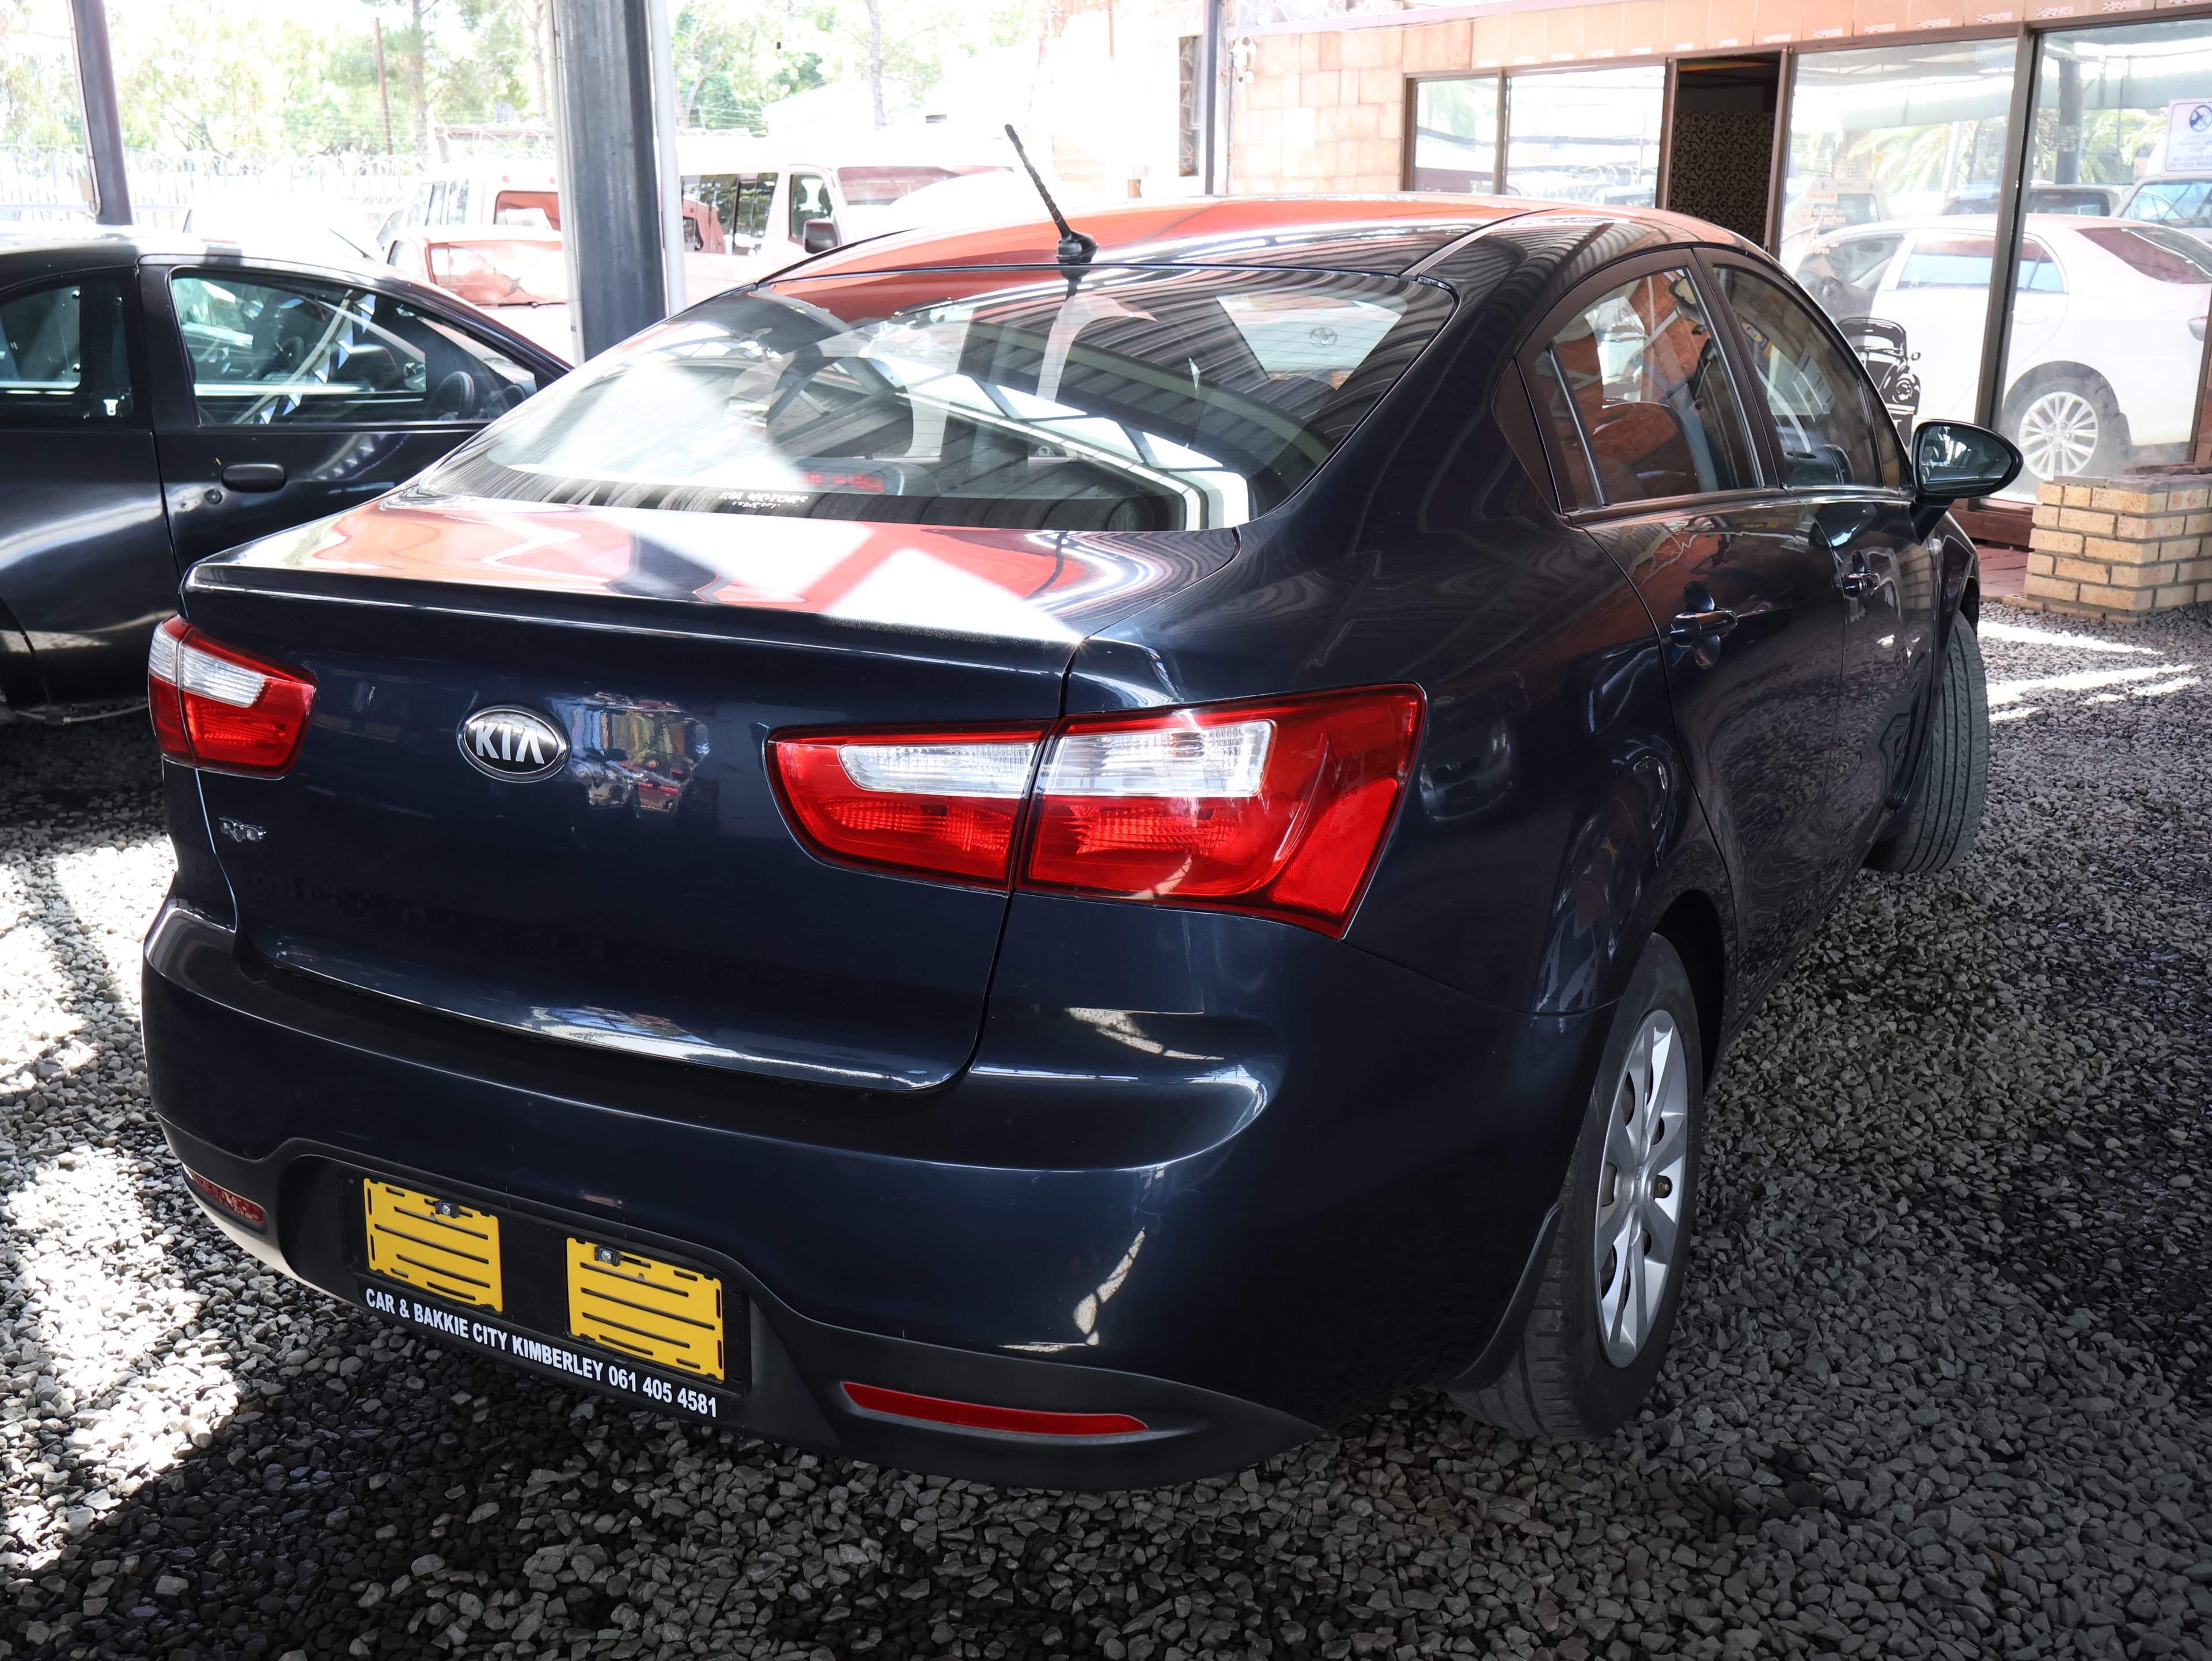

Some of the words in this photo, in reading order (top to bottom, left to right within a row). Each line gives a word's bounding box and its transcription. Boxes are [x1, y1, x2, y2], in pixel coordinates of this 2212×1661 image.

[476, 721, 545, 765] KIA
[366, 1288, 395, 1314] CAR
[399, 1299, 410, 1319] &
[414, 1303, 469, 1338] BAKKIE
[472, 1323, 507, 1350] CITY
[512, 1334, 604, 1381] KIMBERLEY
[608, 1365, 636, 1392] 061
[642, 1376, 672, 1403] 405
[677, 1387, 717, 1418] 4581
